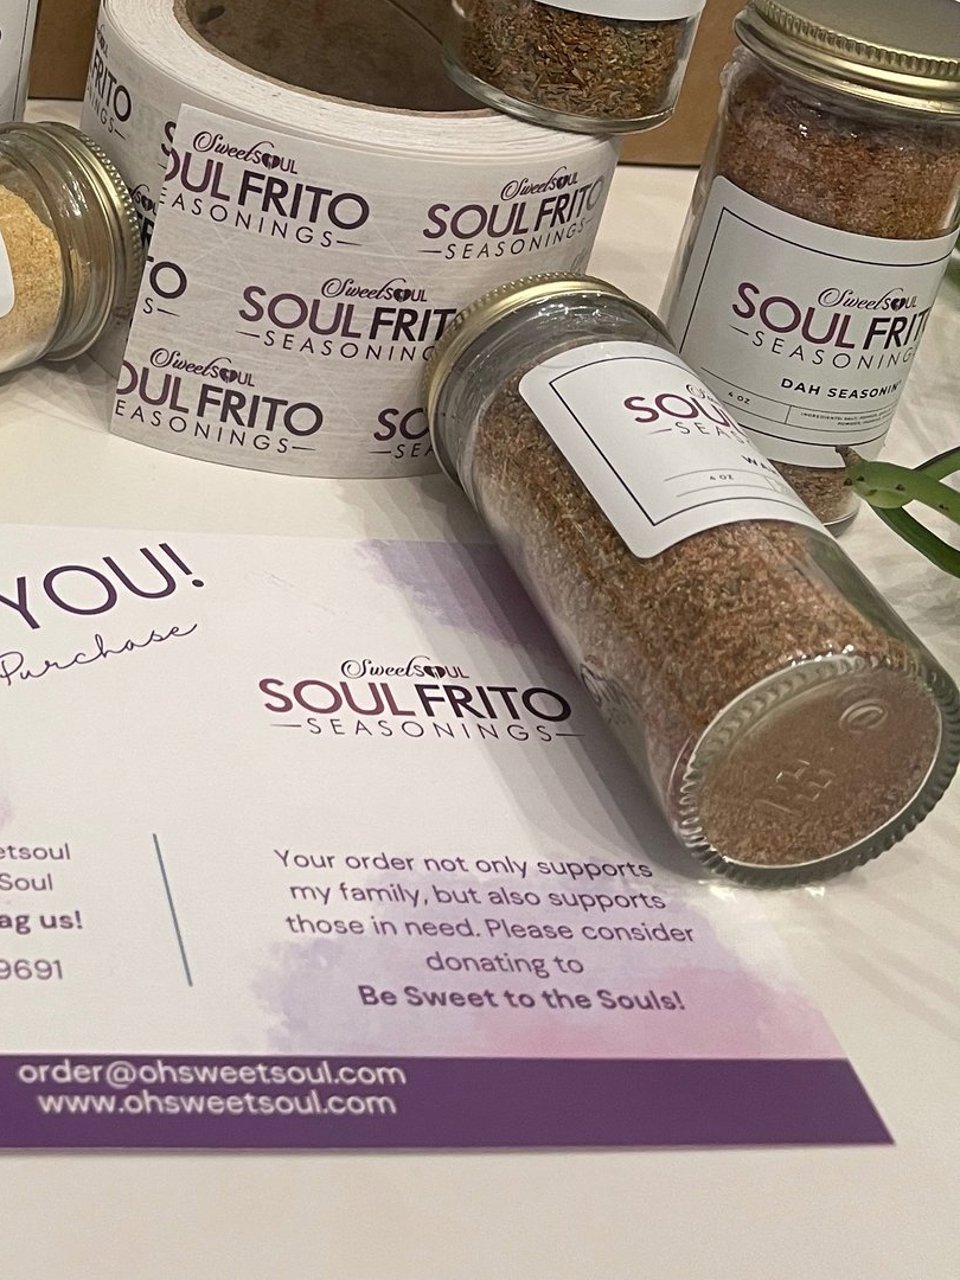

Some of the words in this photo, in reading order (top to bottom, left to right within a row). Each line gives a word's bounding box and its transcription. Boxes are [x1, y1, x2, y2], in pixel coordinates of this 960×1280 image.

[238, 170, 370, 231] FRITO
[423, 203, 529, 240] SOUL
[536, 174, 603, 233] FRITO
[445, 219, 584, 261] SEASONINGS
[239, 286, 362, 339] SOUL
[731, 281, 856, 350] SOUL
[737, 394, 752, 405] OZ
[780, 377, 821, 397] DAH
[196, 383, 324, 438] FRITO
[258, 677, 416, 718] SOUL
[418, 683, 573, 723] FRITO
[306, 716, 553, 743] SEASONINGS
[273, 848, 336, 871] Your
[345, 852, 415, 874] order
[423, 854, 467, 874] not
[475, 856, 528, 879] only
[536, 858, 654, 880] supports
[289, 885, 332, 905] my
[338, 881, 430, 907] family,
[435, 883, 482, 905] but
[488, 886, 541, 907] also
[548, 889, 667, 912] supports
[39, 910, 84, 931] us!
[286, 914, 365, 936] those
[372, 915, 398, 937] in
[404, 916, 481, 939] need.
[488, 917, 574, 940] Please
[581, 922, 696, 944] consider
[426, 950, 550, 980] donating
[553, 955, 585, 975] to
[358, 985, 398, 1007] Be
[406, 987, 499, 1009] Sweet
[503, 989, 536, 1009] to
[541, 989, 593, 1011] the
[600, 988, 686, 1011] Souls!
[16, 1059, 407, 1089] order@ohsweetsoul.com
[37, 1089, 398, 1116] www.ohsweetsoul.com
